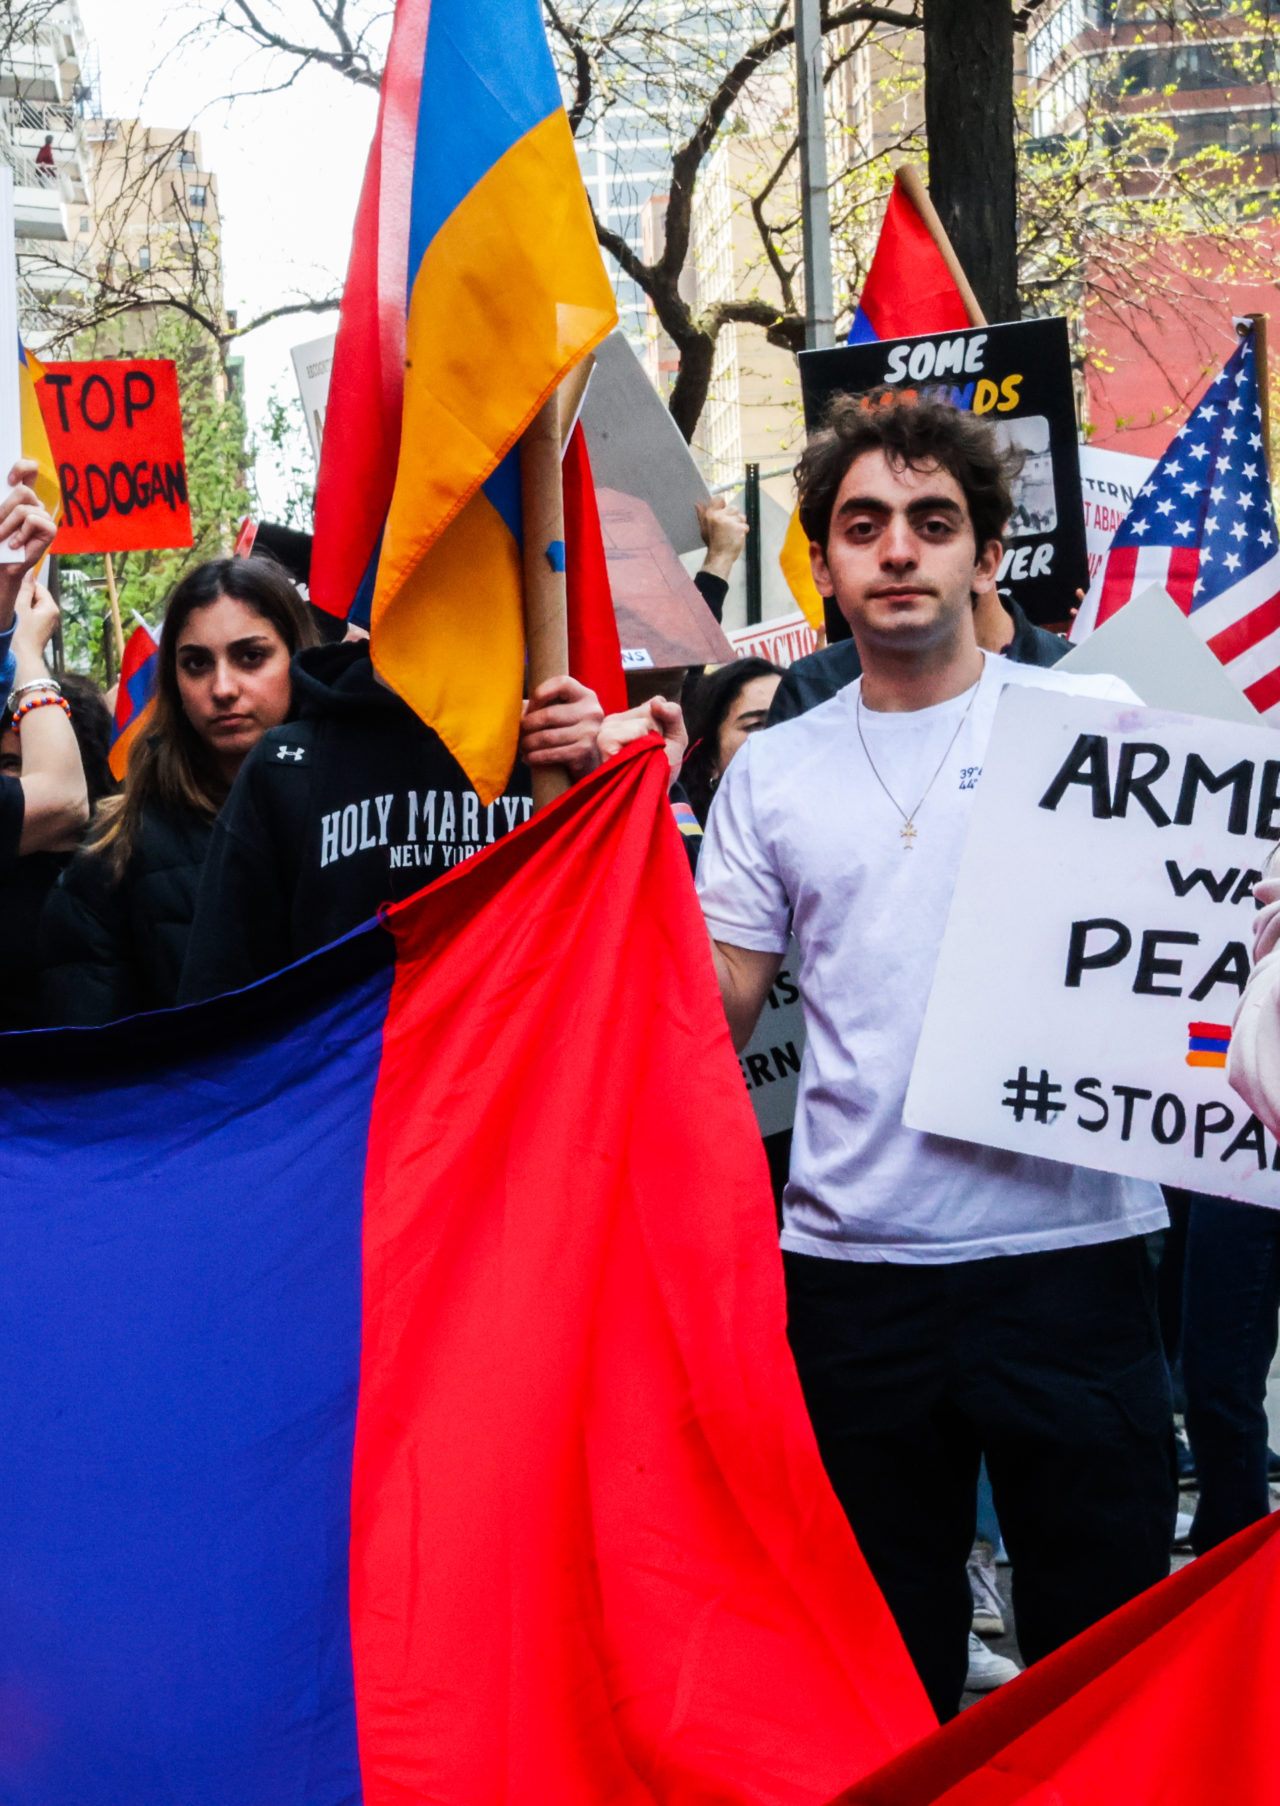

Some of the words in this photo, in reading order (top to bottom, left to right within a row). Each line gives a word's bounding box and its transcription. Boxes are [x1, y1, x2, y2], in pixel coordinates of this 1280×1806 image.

[883, 334, 988, 384] SOME
[58, 460, 188, 527] RDOGAN
[320, 794, 394, 868] HOLY
[389, 844, 433, 869] NEW
[441, 845, 486, 867] YOR
[1165, 860, 1266, 911] WA
[1064, 917, 1252, 1001] PEA
[1002, 1065, 1280, 1172] #STOPA
